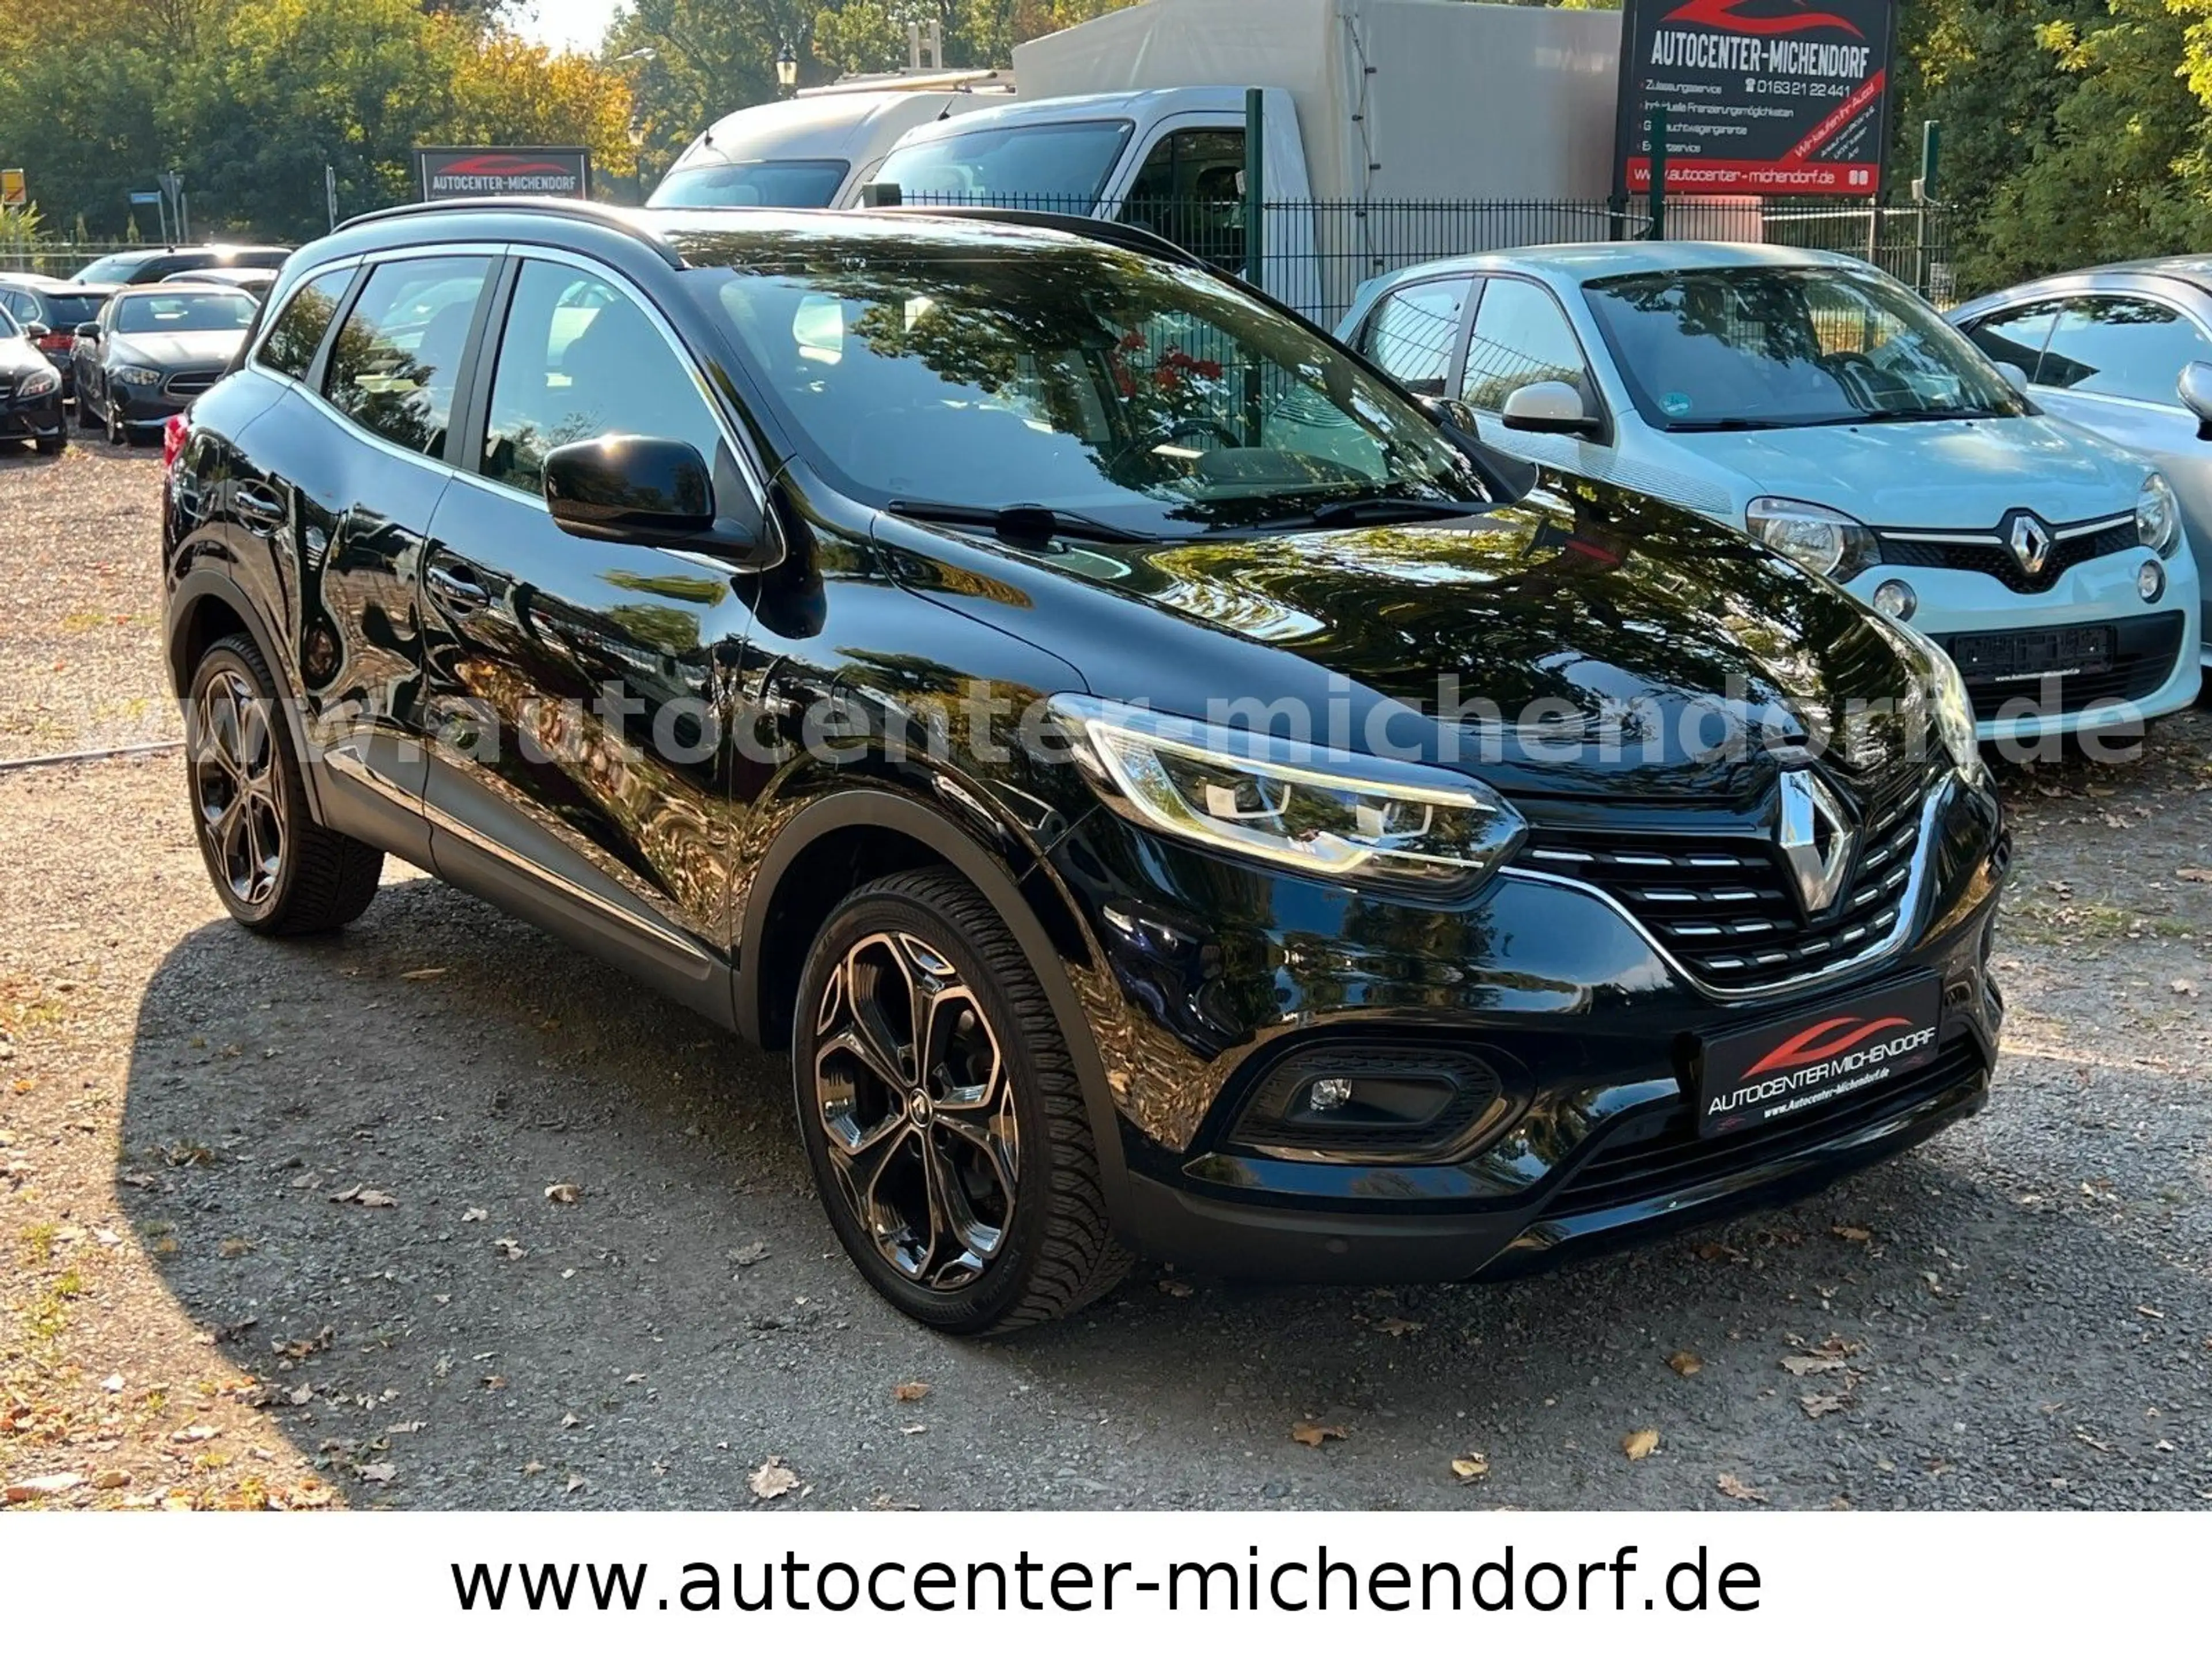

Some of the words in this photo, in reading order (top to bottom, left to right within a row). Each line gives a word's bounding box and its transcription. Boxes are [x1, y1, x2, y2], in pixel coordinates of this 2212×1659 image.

[1650, 31, 1870, 78] AUTOCENTER-MICHENDORF
[433, 176, 576, 190] AUTOCENTER-MICHENDORF
[1707, 1063, 1829, 1115] AUTOCENTER
[1831, 1027, 1936, 1077] MICHENDORF
